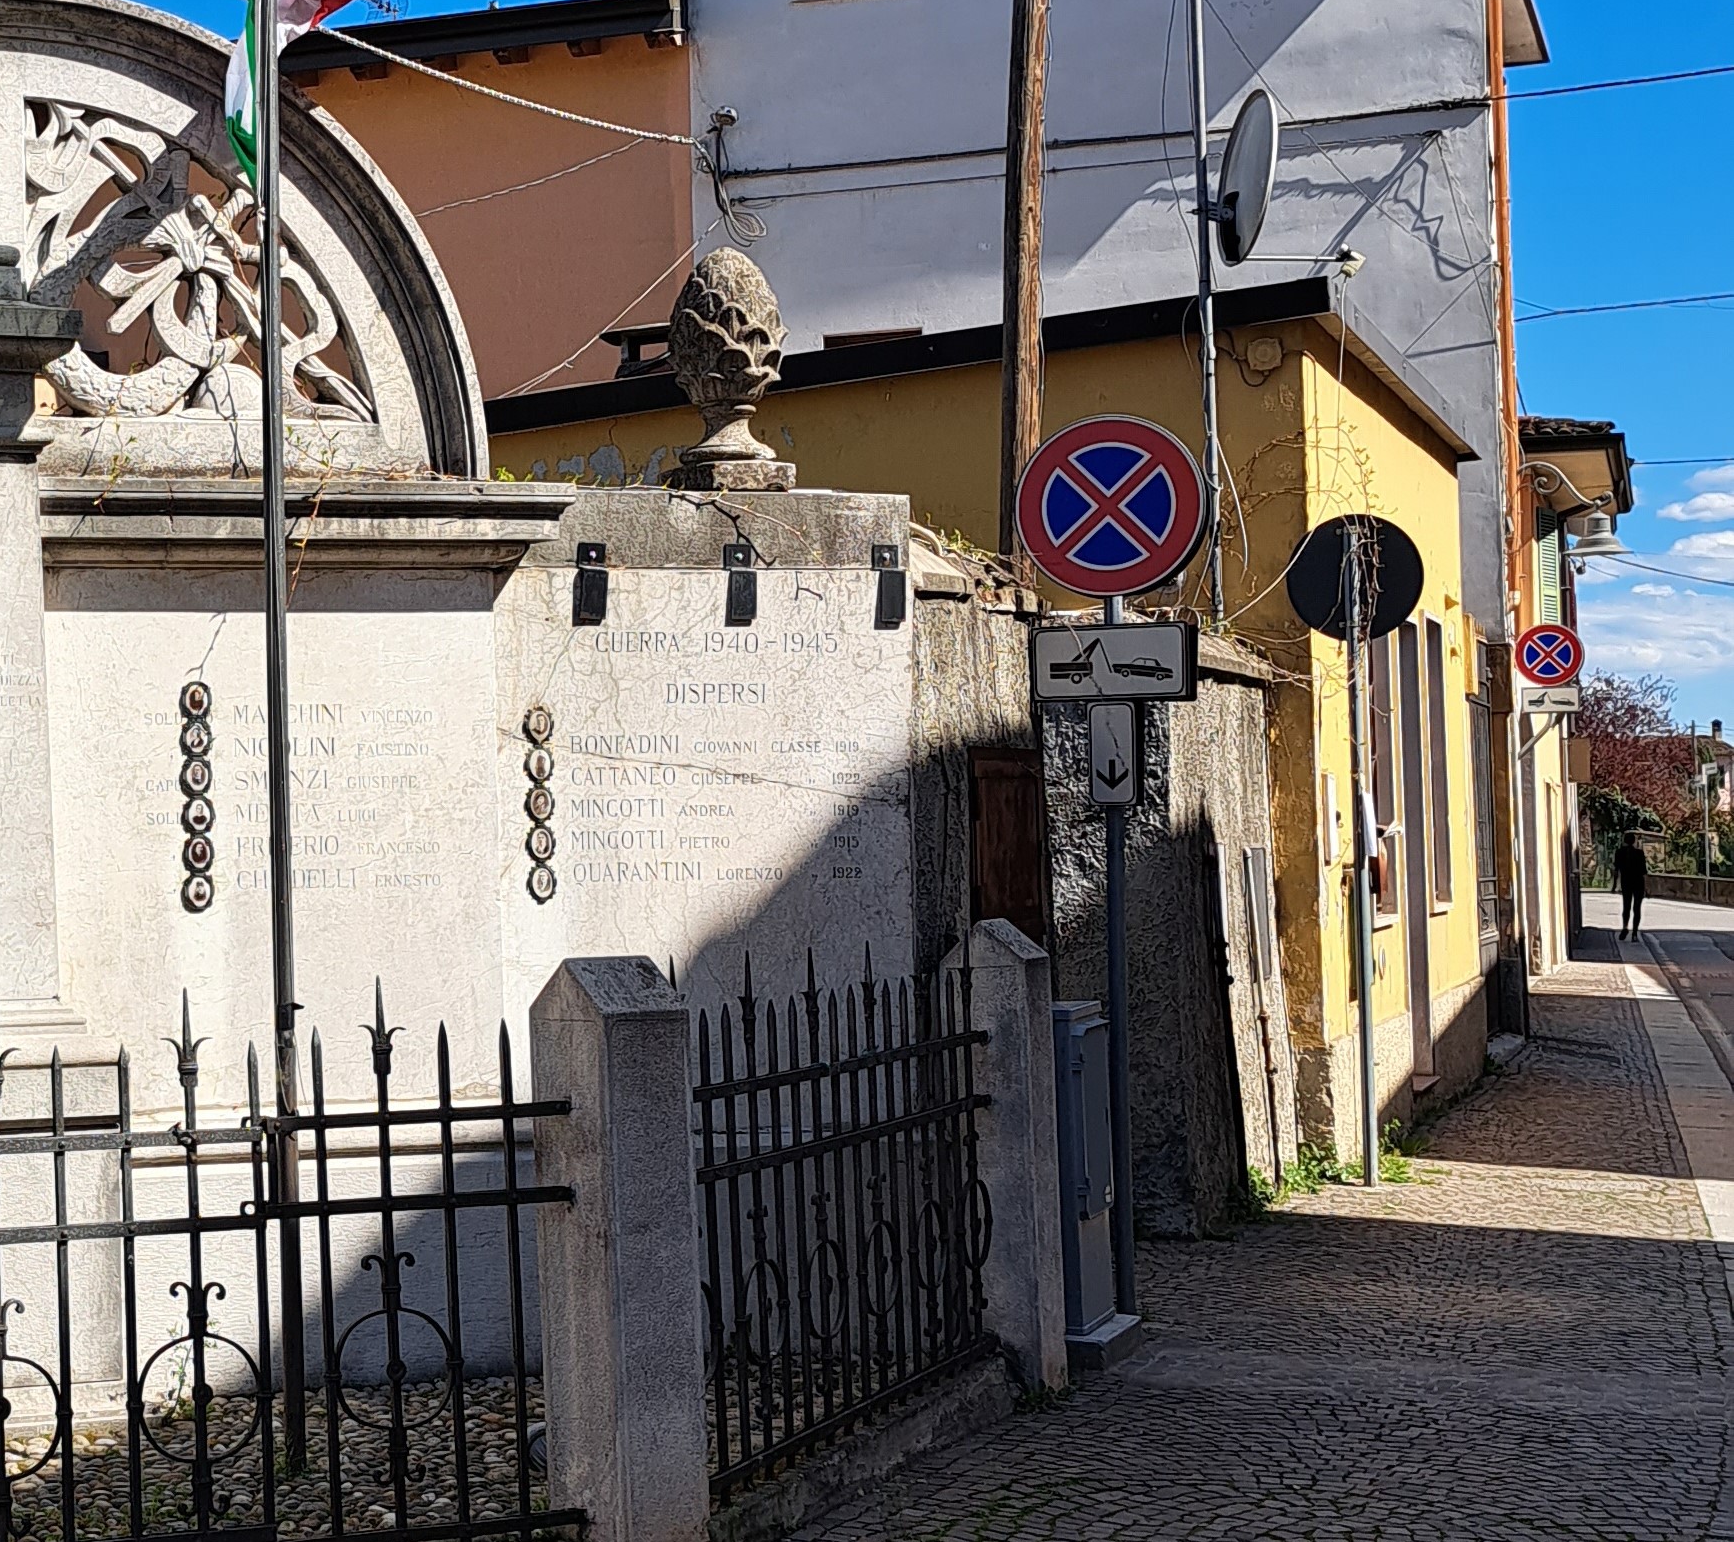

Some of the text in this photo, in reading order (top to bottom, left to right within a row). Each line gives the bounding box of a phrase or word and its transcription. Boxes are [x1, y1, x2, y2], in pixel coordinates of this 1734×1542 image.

[666, 682, 766, 705] DISPERSI
[232, 703, 344, 726] MACHINI
[233, 735, 336, 758] NICLINI
[771, 740, 822, 754] CLASSE
[834, 740, 860, 753] 1919
[233, 768, 329, 791] SMNZI
[570, 766, 676, 787] CATTANEO
[832, 772, 861, 785] 1922
[678, 804, 735, 817] ANDREA
[357, 841, 441, 855] FRANCESCO
[679, 835, 731, 849] PIETRO
[833, 835, 860, 849] 1915
[374, 873, 441, 887] ERNESTO
[572, 861, 702, 884] QUARANTINI
[716, 867, 783, 882] LORENZO
[832, 866, 863, 880] 1922
